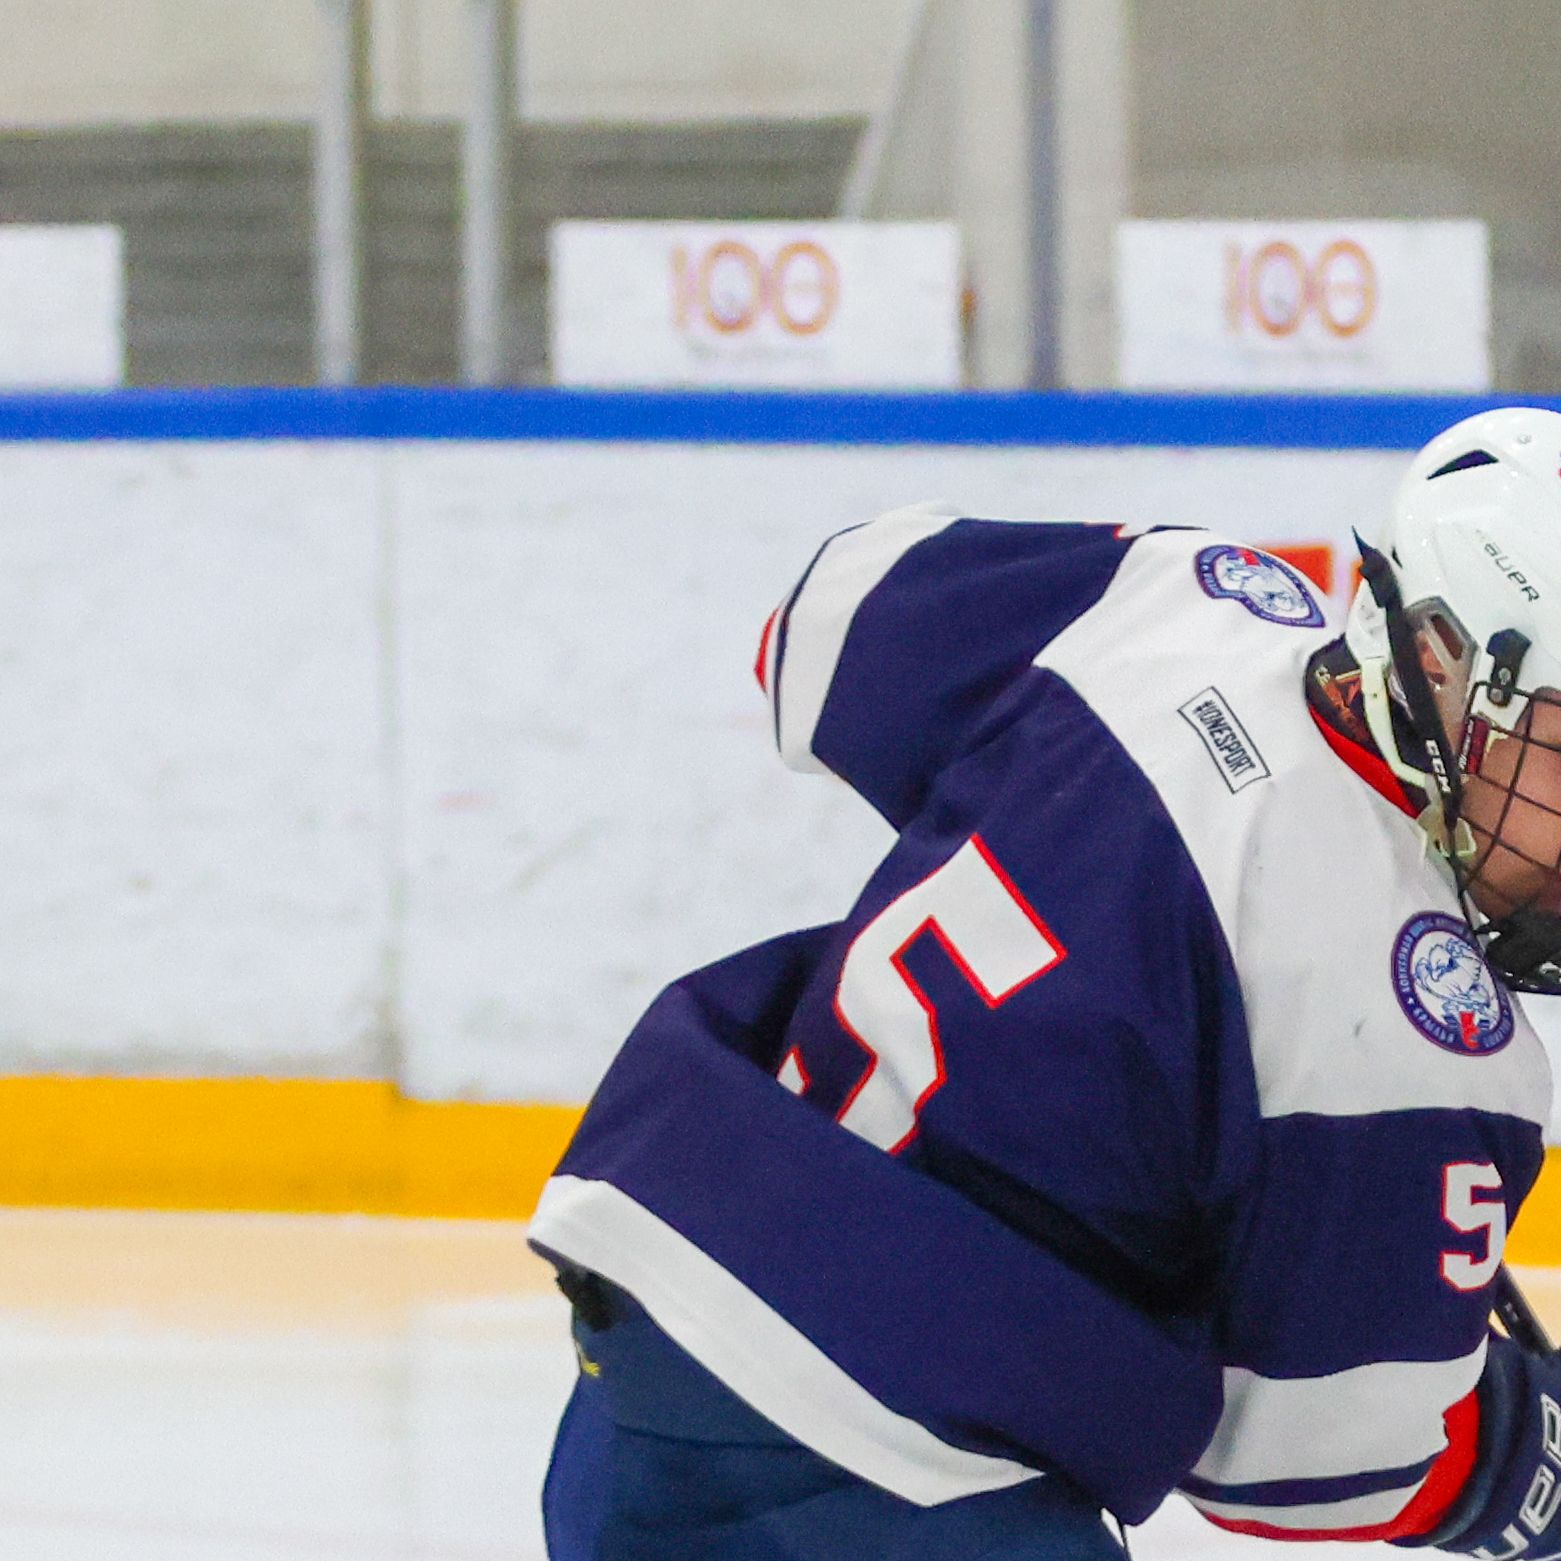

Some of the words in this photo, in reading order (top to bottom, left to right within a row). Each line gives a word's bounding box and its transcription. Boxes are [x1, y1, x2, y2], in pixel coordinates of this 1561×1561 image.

[672, 240, 840, 337] 100
[1223, 238, 1378, 339] 100
[1440, 1160, 1507, 1292] 5
